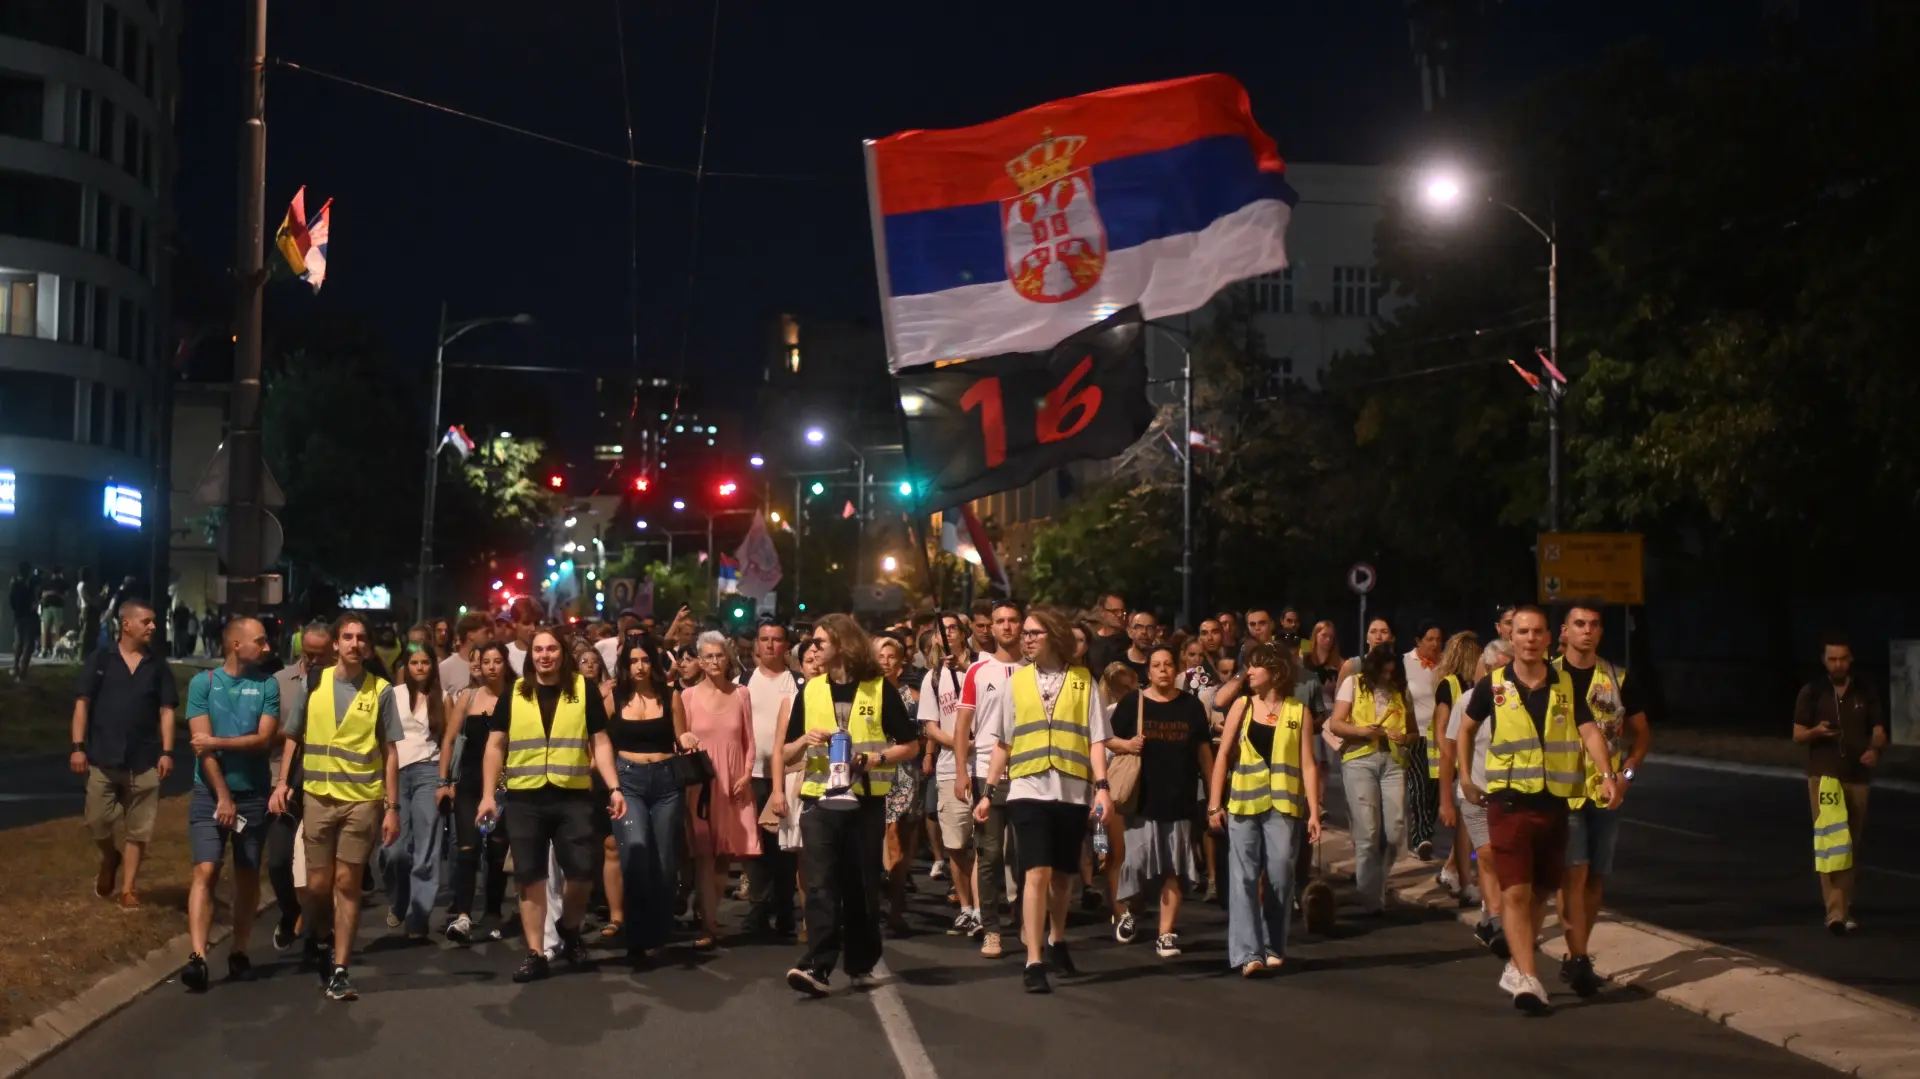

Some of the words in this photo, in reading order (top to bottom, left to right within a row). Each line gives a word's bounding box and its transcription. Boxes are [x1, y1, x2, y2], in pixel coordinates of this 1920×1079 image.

[959, 354, 1104, 469] 16
[1073, 682, 1085, 691] 13
[357, 702, 371, 712] 11
[859, 706, 875, 716] 25
[1286, 720, 1298, 729] 19
[1819, 792, 1839, 805] ESS
